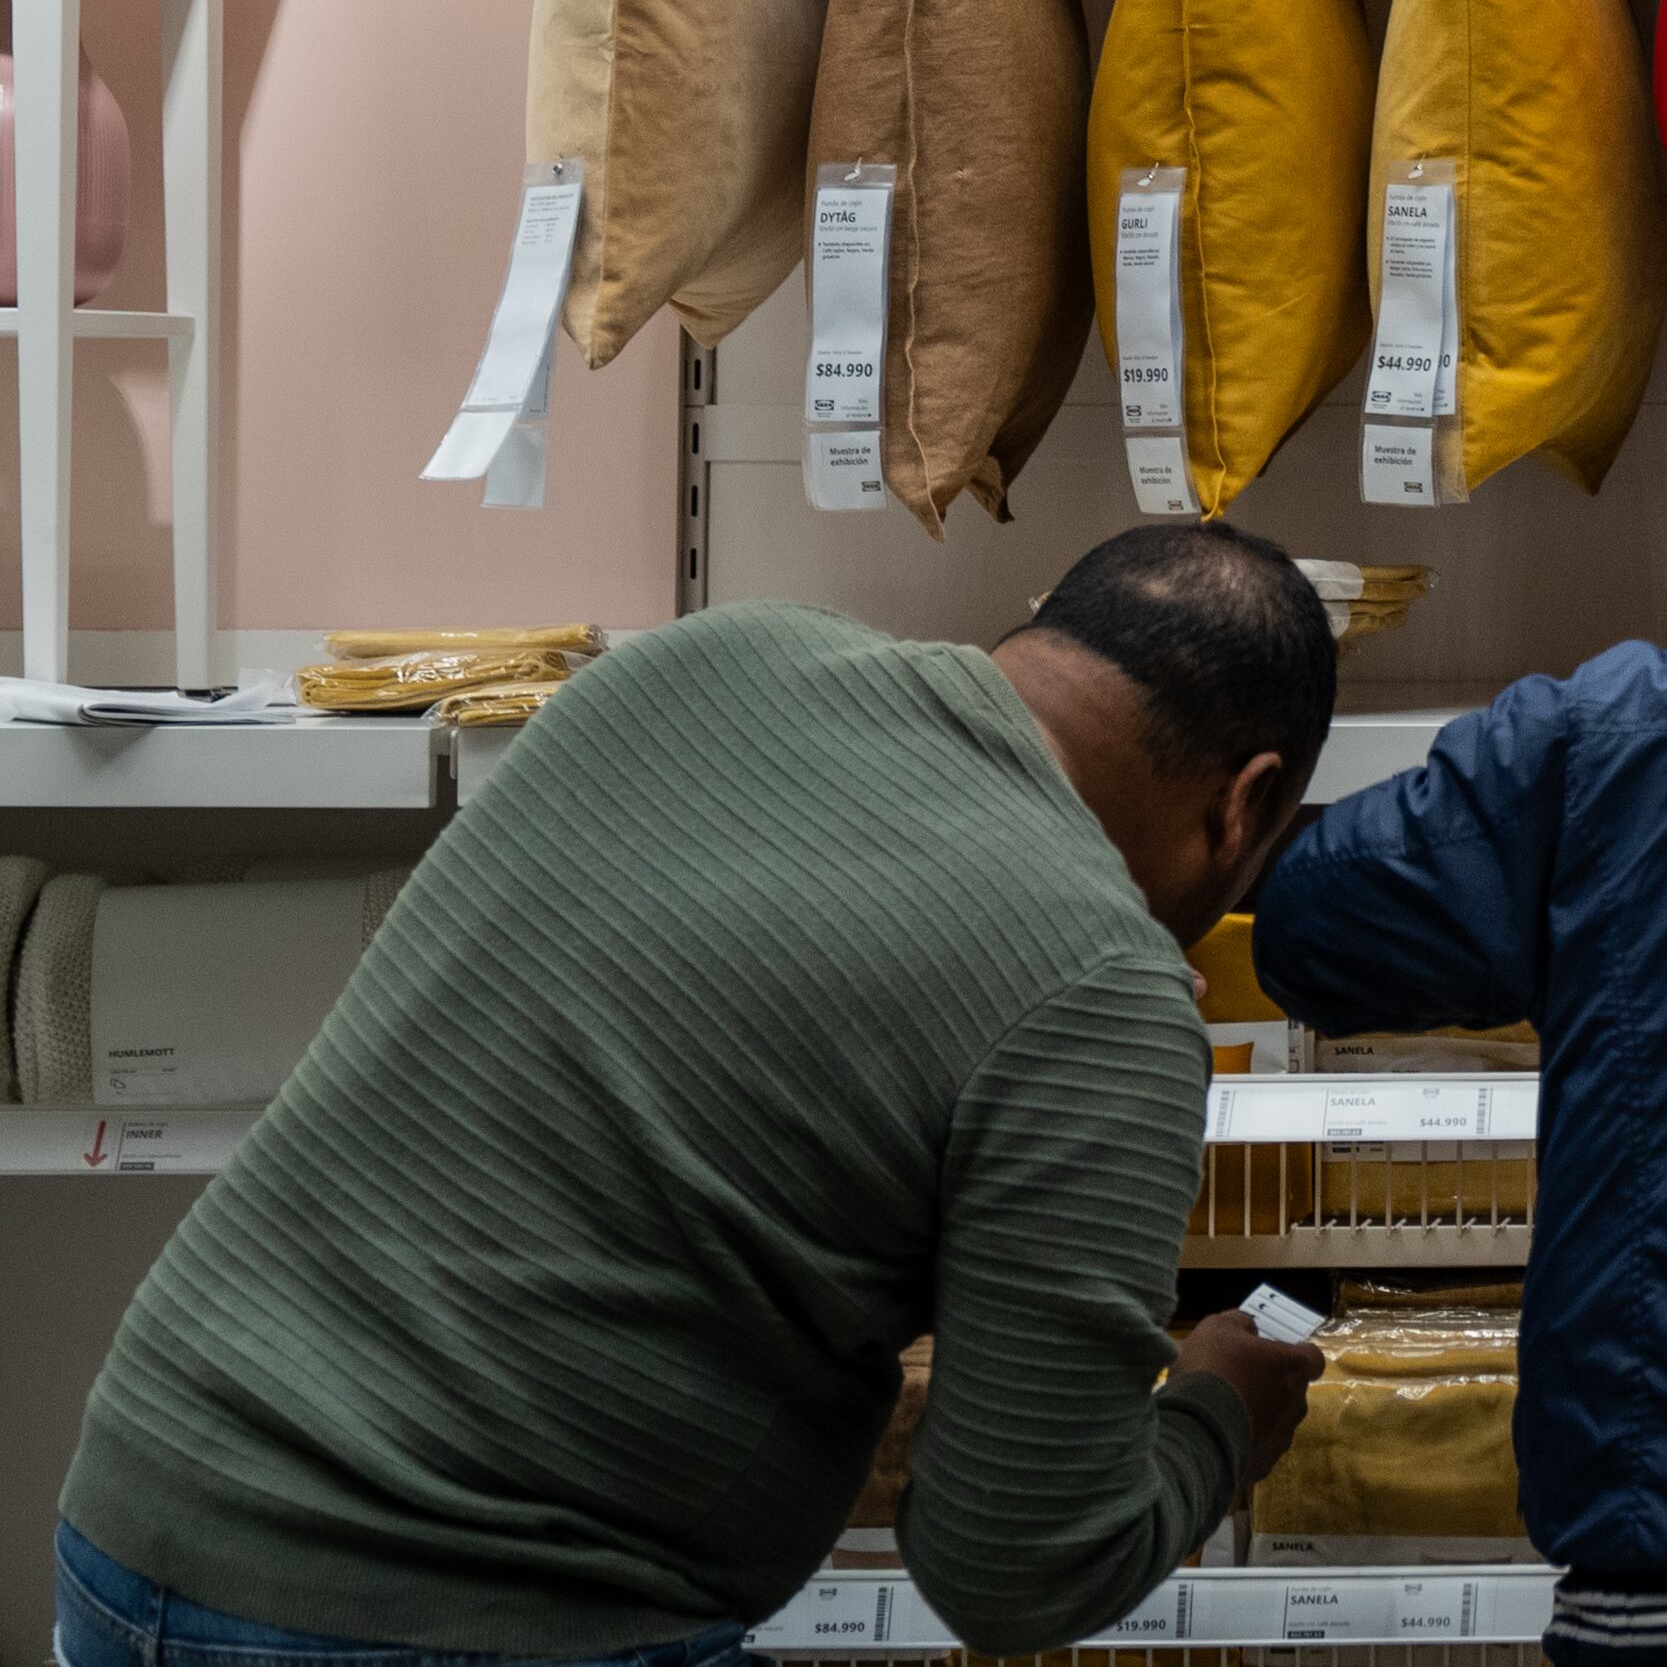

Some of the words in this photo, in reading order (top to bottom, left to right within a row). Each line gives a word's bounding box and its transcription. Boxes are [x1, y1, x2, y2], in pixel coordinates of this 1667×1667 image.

[820, 210, 856, 223] DYTÅG
[1388, 206, 1427, 218] SANELA
[1121, 217, 1148, 229] GURLI
[1377, 355, 1432, 372] $44.990
[816, 363, 873, 377] $84.990
[1123, 367, 1168, 383] $19.990
[829, 447, 860, 455] Muestra
[861, 446, 871, 455] de
[1374, 445, 1405, 455] Muestra
[1406, 446, 1416, 456] de
[1334, 1046, 1374, 1056] SANELA
[1329, 1097, 1377, 1107] SANELA
[1419, 1117, 1467, 1128] $44.990
[1272, 1541, 1314, 1552] SANELA
[1290, 1594, 1338, 1605] SANELA
[814, 1622, 866, 1634] $84.990
[1401, 1617, 1451, 1628] $44.990
